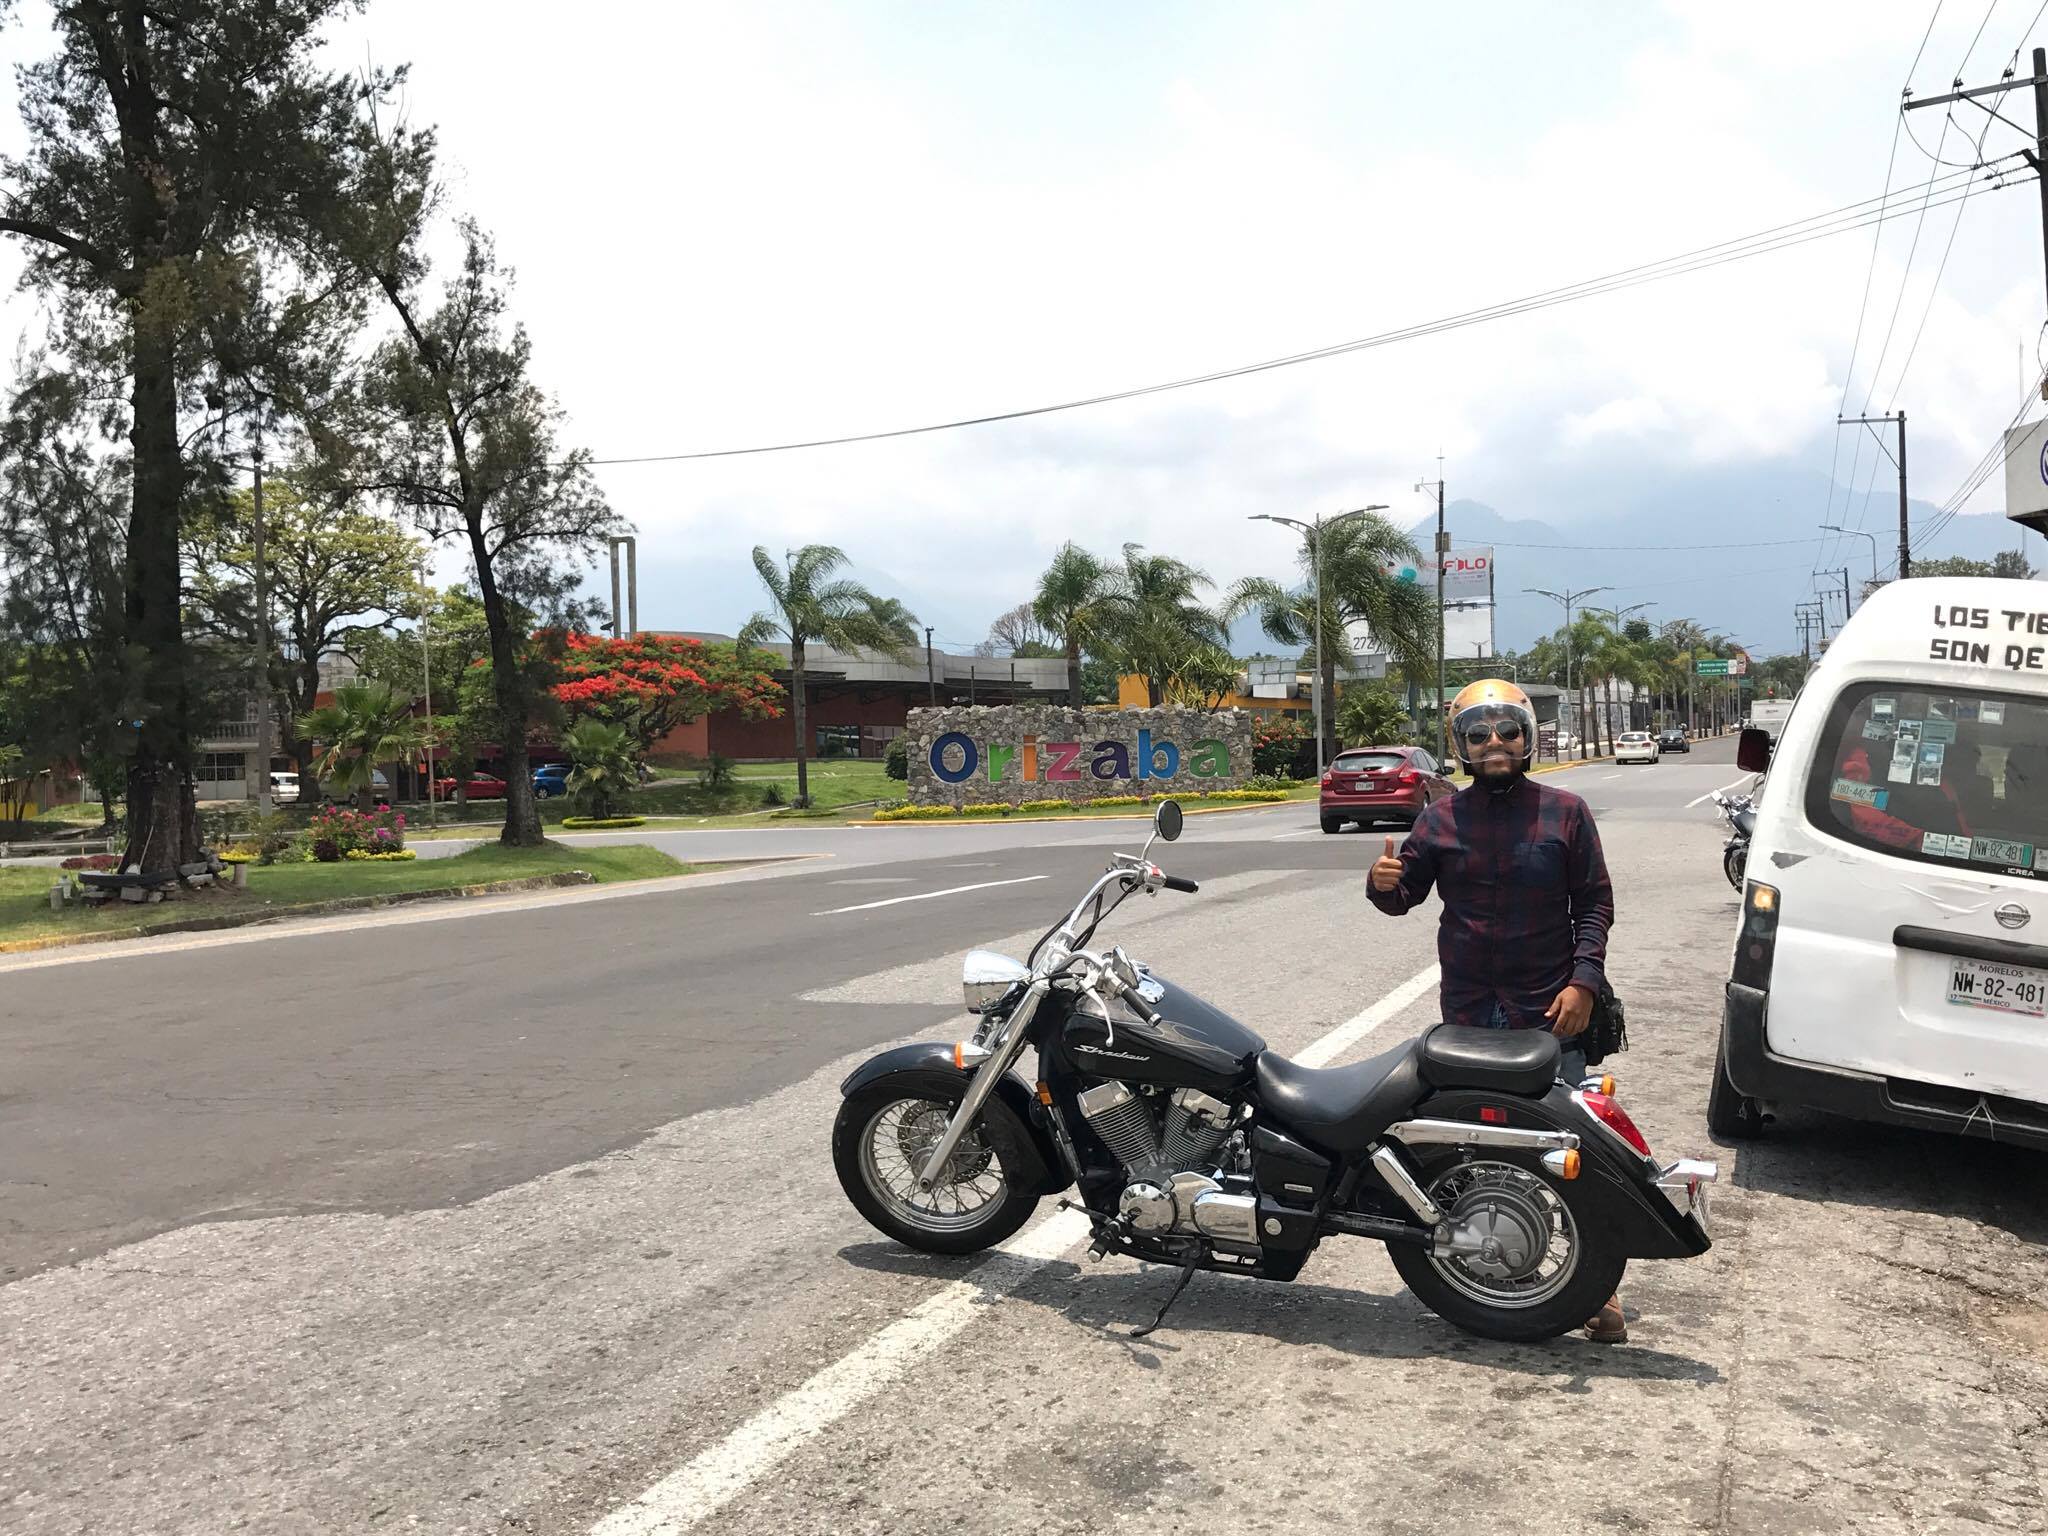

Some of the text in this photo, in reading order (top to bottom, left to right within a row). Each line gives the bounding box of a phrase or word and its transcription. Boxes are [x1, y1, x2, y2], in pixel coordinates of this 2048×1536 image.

[1934, 605, 1989, 629] LOS
[1930, 639, 2045, 670] SON DE
[929, 728, 1231, 784] Orizaba
[1978, 965, 2024, 978] MORELOS
[1953, 971, 2045, 1005] NW-82-481
[1073, 1044, 1150, 1061] Shadow
